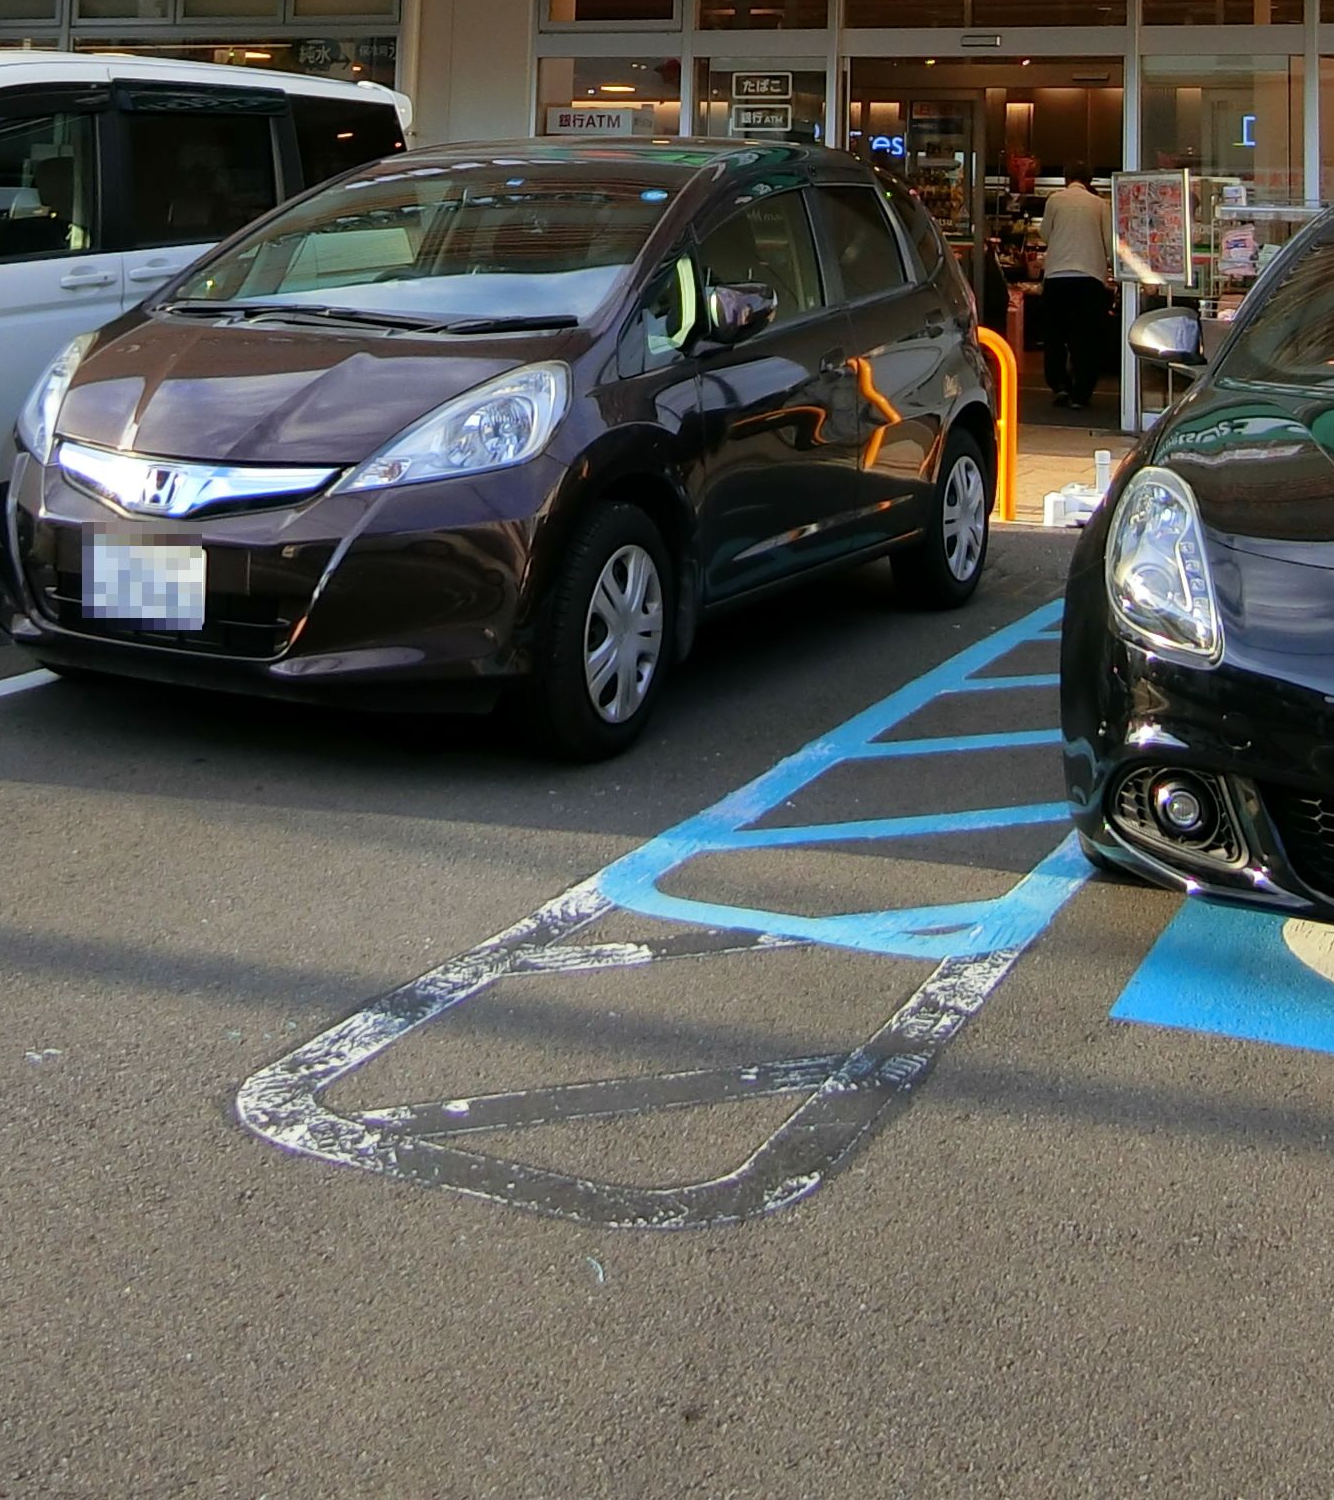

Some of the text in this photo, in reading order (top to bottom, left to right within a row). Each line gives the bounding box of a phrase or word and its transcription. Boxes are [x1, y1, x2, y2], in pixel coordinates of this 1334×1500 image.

[742, 78, 782, 93] たばこ
[558, 114, 621, 129] 銀行ATM
